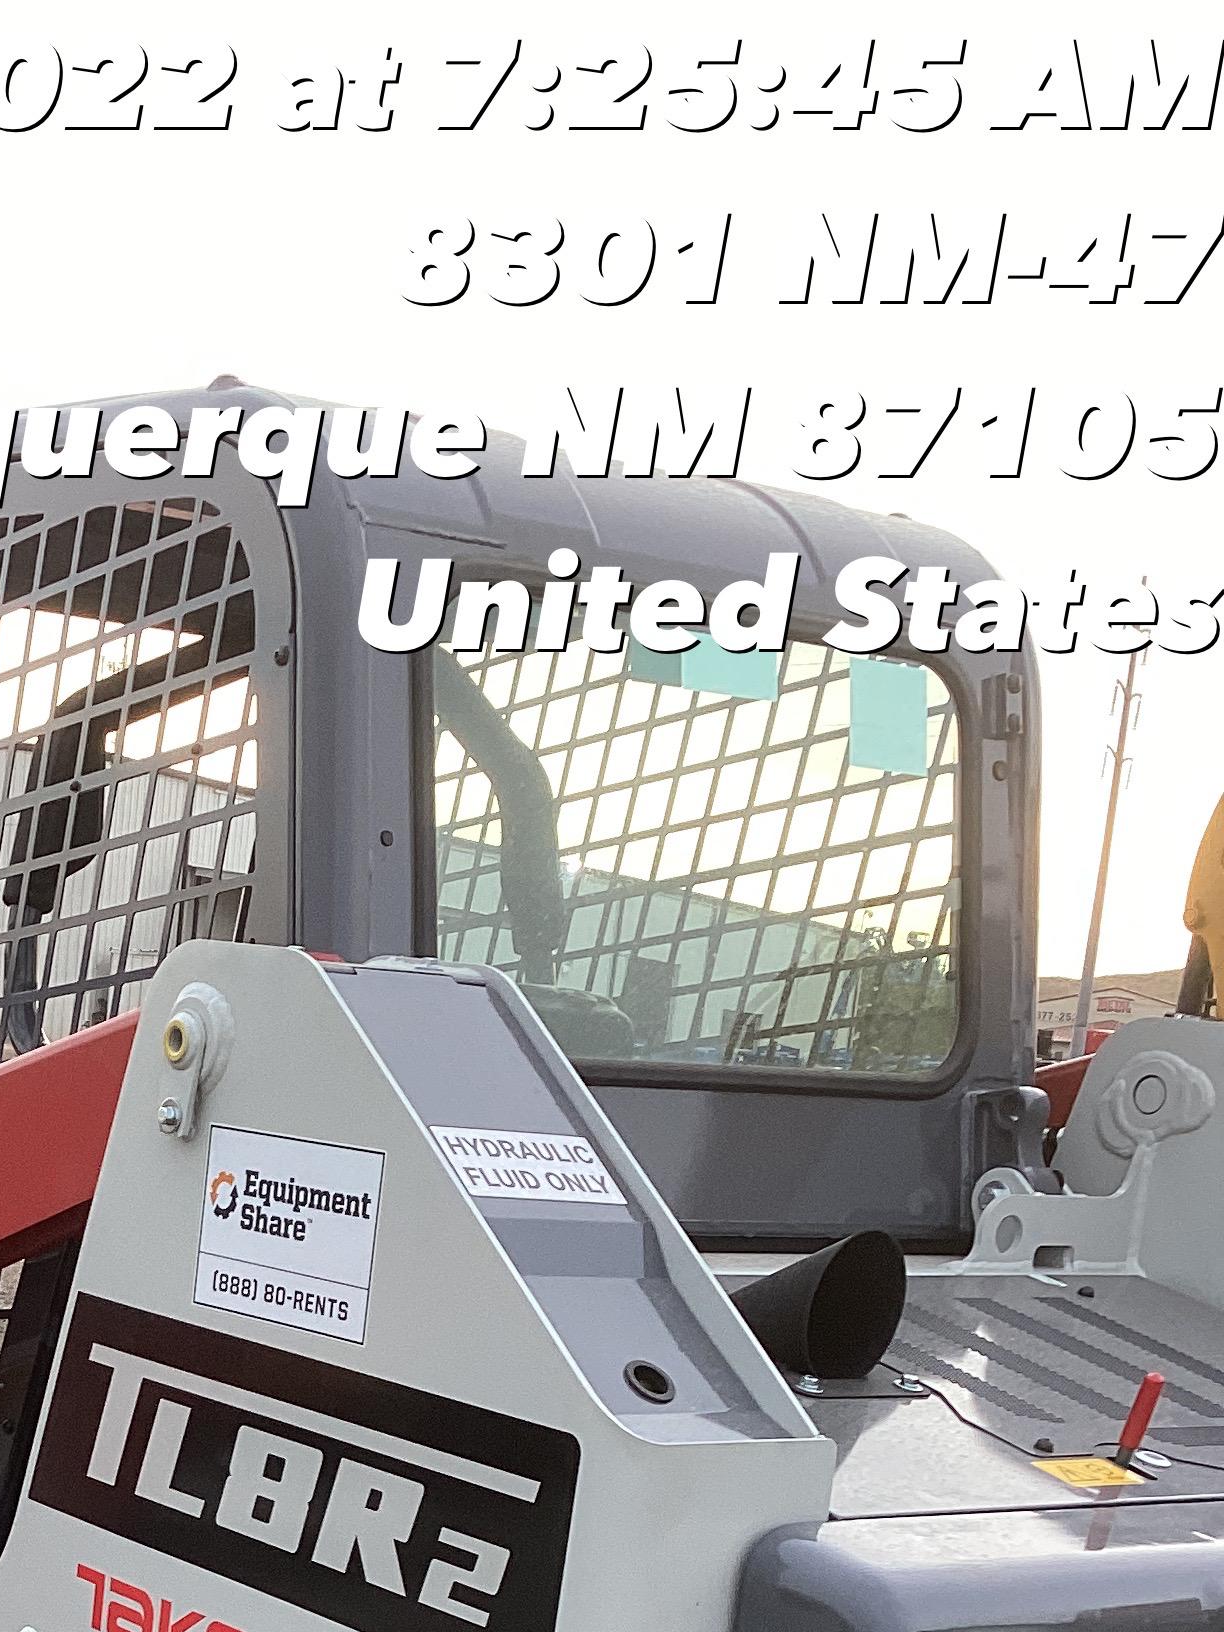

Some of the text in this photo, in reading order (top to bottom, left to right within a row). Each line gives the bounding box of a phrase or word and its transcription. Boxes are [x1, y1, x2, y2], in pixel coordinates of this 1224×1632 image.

[442, 1135, 594, 1165] HYDRAULIC
[243, 1169, 372, 1220] Equipment
[462, 1166, 610, 1195] FLUID ONLY
[240, 1203, 307, 1242] Share
[212, 1269, 350, 1322] (888) 80-RENTS
[86, 1342, 541, 1628] TL8R2
